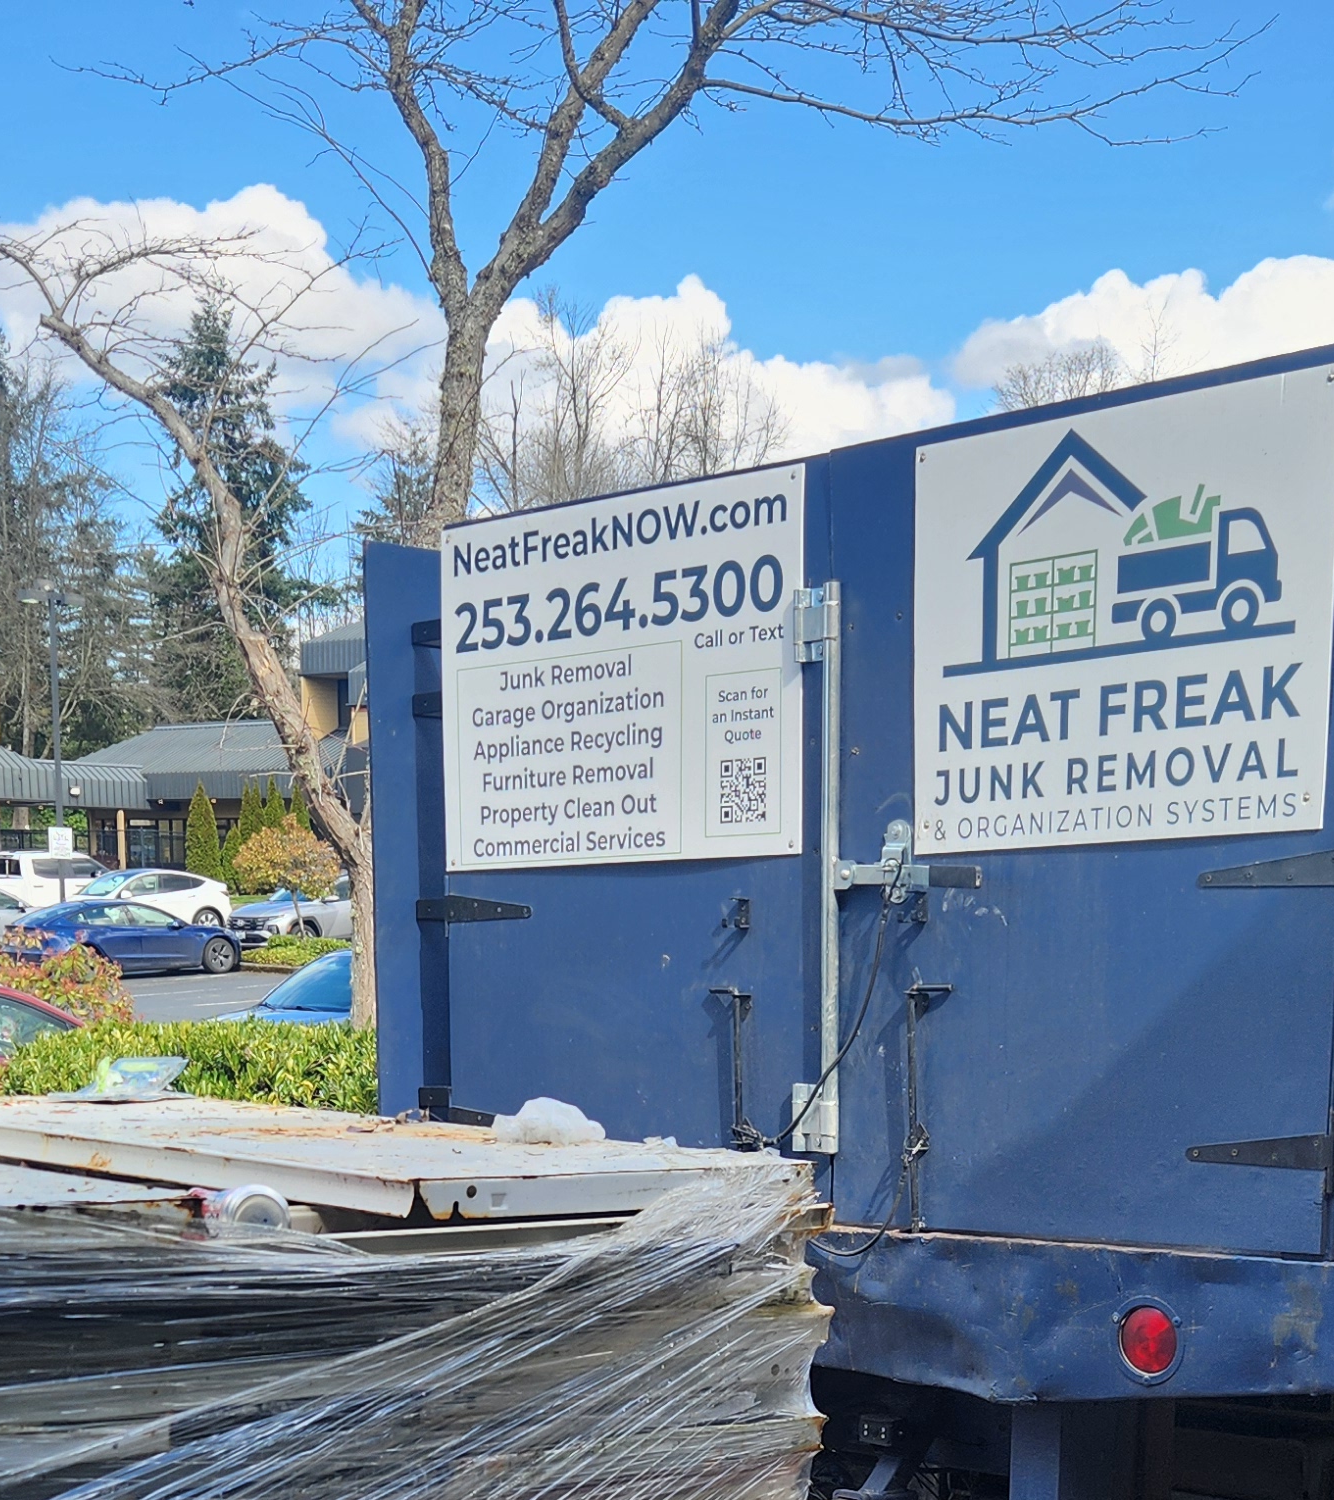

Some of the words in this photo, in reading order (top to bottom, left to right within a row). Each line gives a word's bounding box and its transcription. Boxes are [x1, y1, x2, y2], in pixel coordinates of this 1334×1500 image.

[453, 493, 787, 577] NeatFreakNOW.com
[455, 554, 783, 654] 253.264.5300
[694, 631, 723, 650] Call
[728, 631, 745, 645] or
[749, 624, 784, 642] Text
[499, 667, 545, 692] Junk
[551, 654, 633, 686] Removal
[472, 702, 535, 728] Garage
[541, 688, 664, 723] Organization
[718, 689, 748, 703] Scan
[751, 686, 769, 700] for
[938, 688, 1080, 753] NEAT
[1098, 662, 1303, 736] FREAK
[712, 712, 727, 724] an
[730, 705, 774, 723] Instant
[473, 734, 565, 764] Appliance
[570, 724, 663, 752] Recycling
[724, 728, 761, 744] Quote
[482, 768, 567, 792] Furniture
[572, 757, 654, 785] Removal
[934, 761, 1045, 806] JUNK
[1067, 738, 1299, 796] REMOVAL
[480, 803, 558, 828] Property
[563, 795, 616, 820] Clean
[621, 793, 657, 815] Out
[934, 820, 947, 841] &
[958, 803, 1153, 839] ORGANIZATION
[1167, 793, 1297, 824] SYSTEMS
[473, 831, 580, 858] Commercial
[586, 829, 666, 853] Services
